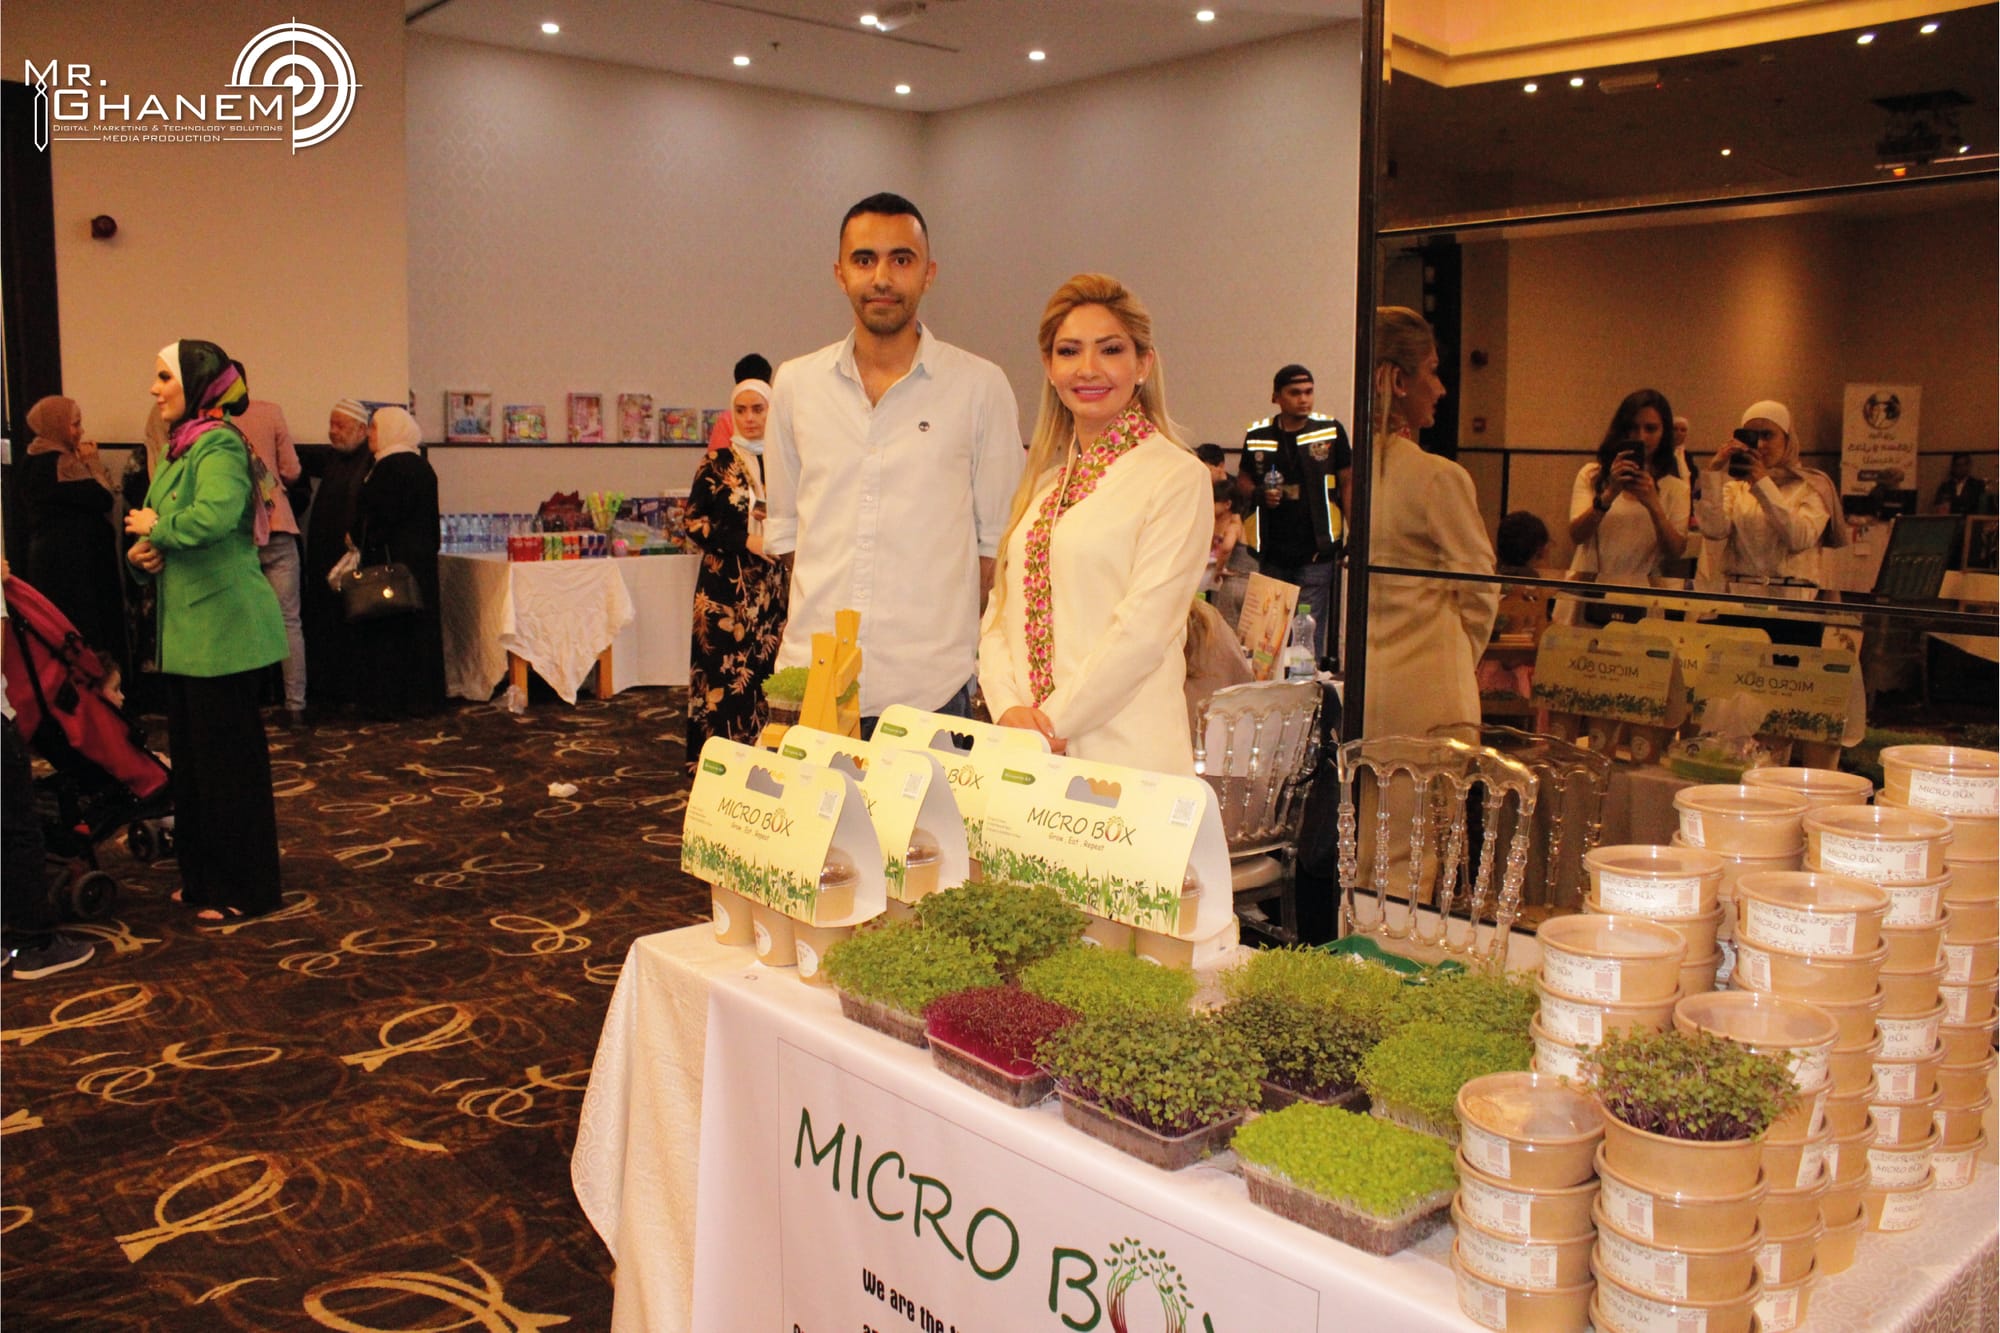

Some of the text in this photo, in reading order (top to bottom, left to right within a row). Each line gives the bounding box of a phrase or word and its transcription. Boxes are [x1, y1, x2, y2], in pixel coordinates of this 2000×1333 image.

[947, 765, 984, 790] BOX
[1919, 784, 1950, 797] MICRO
[717, 797, 761, 825] MICRO
[761, 807, 794, 837] BOX
[1027, 807, 1088, 835] MICRO
[1091, 815, 1137, 846] BOX
[794, 1106, 1019, 1280] MICRO
[862, 1266, 944, 1333] We are the
